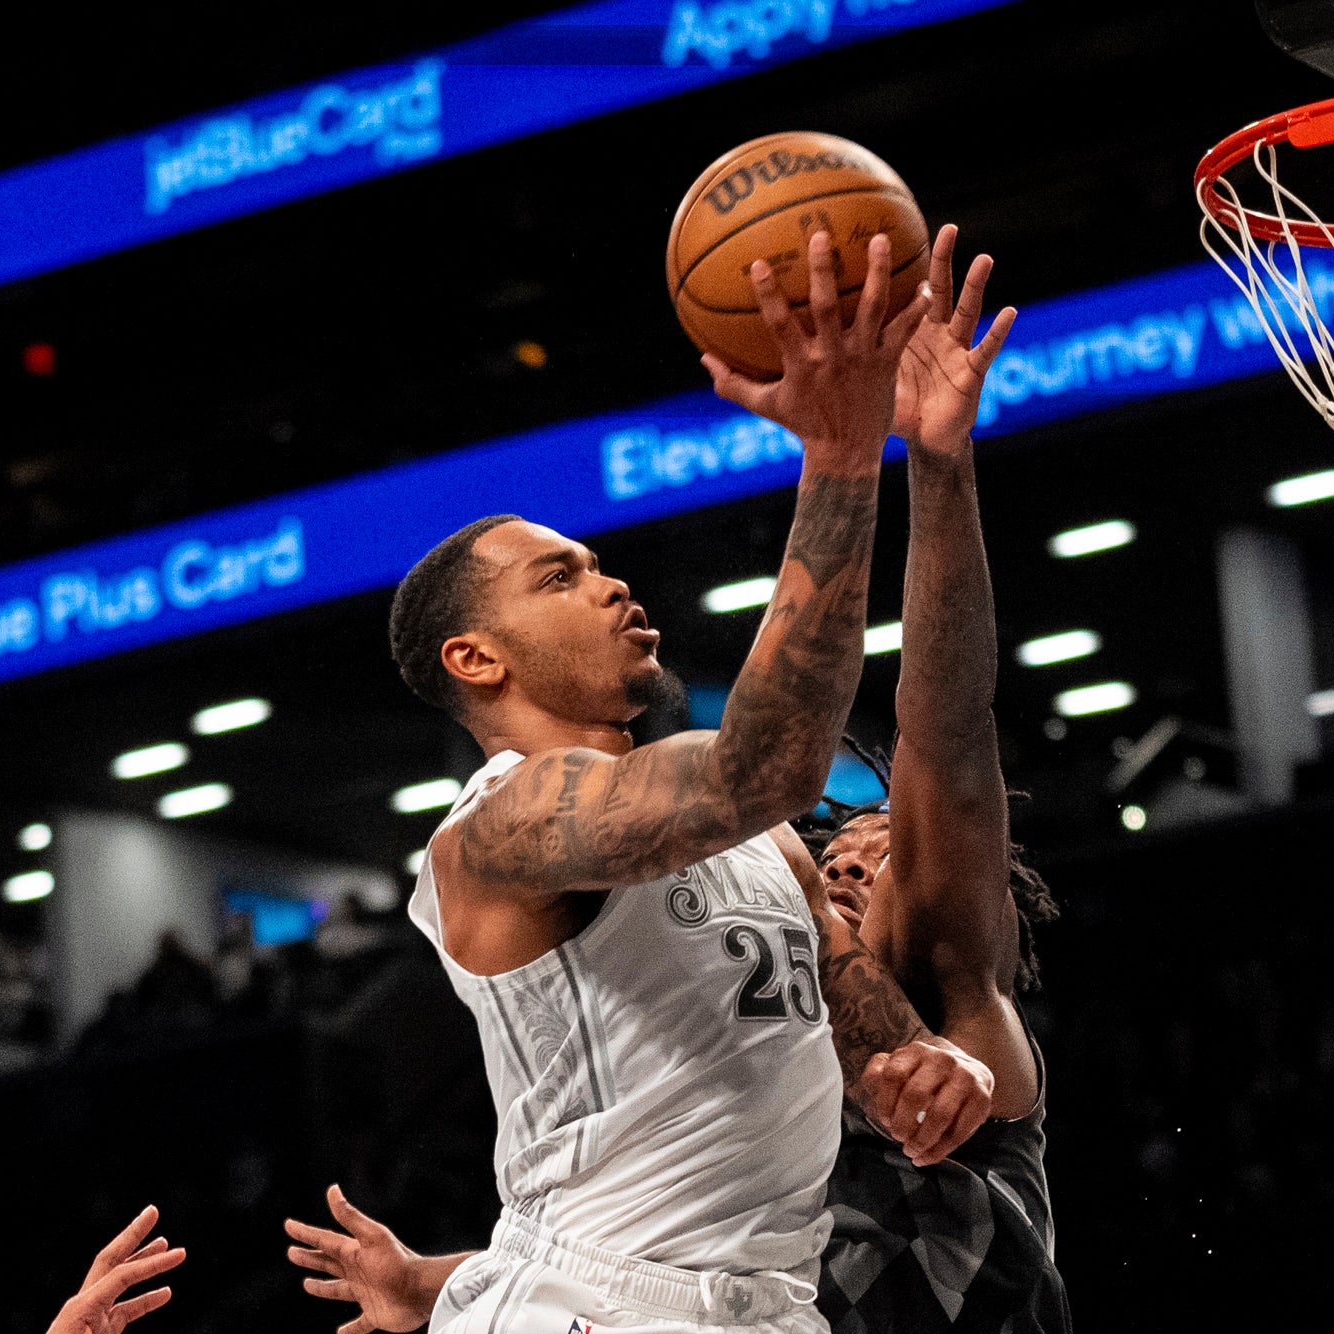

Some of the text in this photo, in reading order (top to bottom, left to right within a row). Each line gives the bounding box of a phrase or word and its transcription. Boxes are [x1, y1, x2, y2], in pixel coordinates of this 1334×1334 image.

[602, 417, 804, 499] Elevat
[40, 566, 163, 642] Plus
[162, 515, 306, 609] Card
[722, 925, 822, 1026] 25
